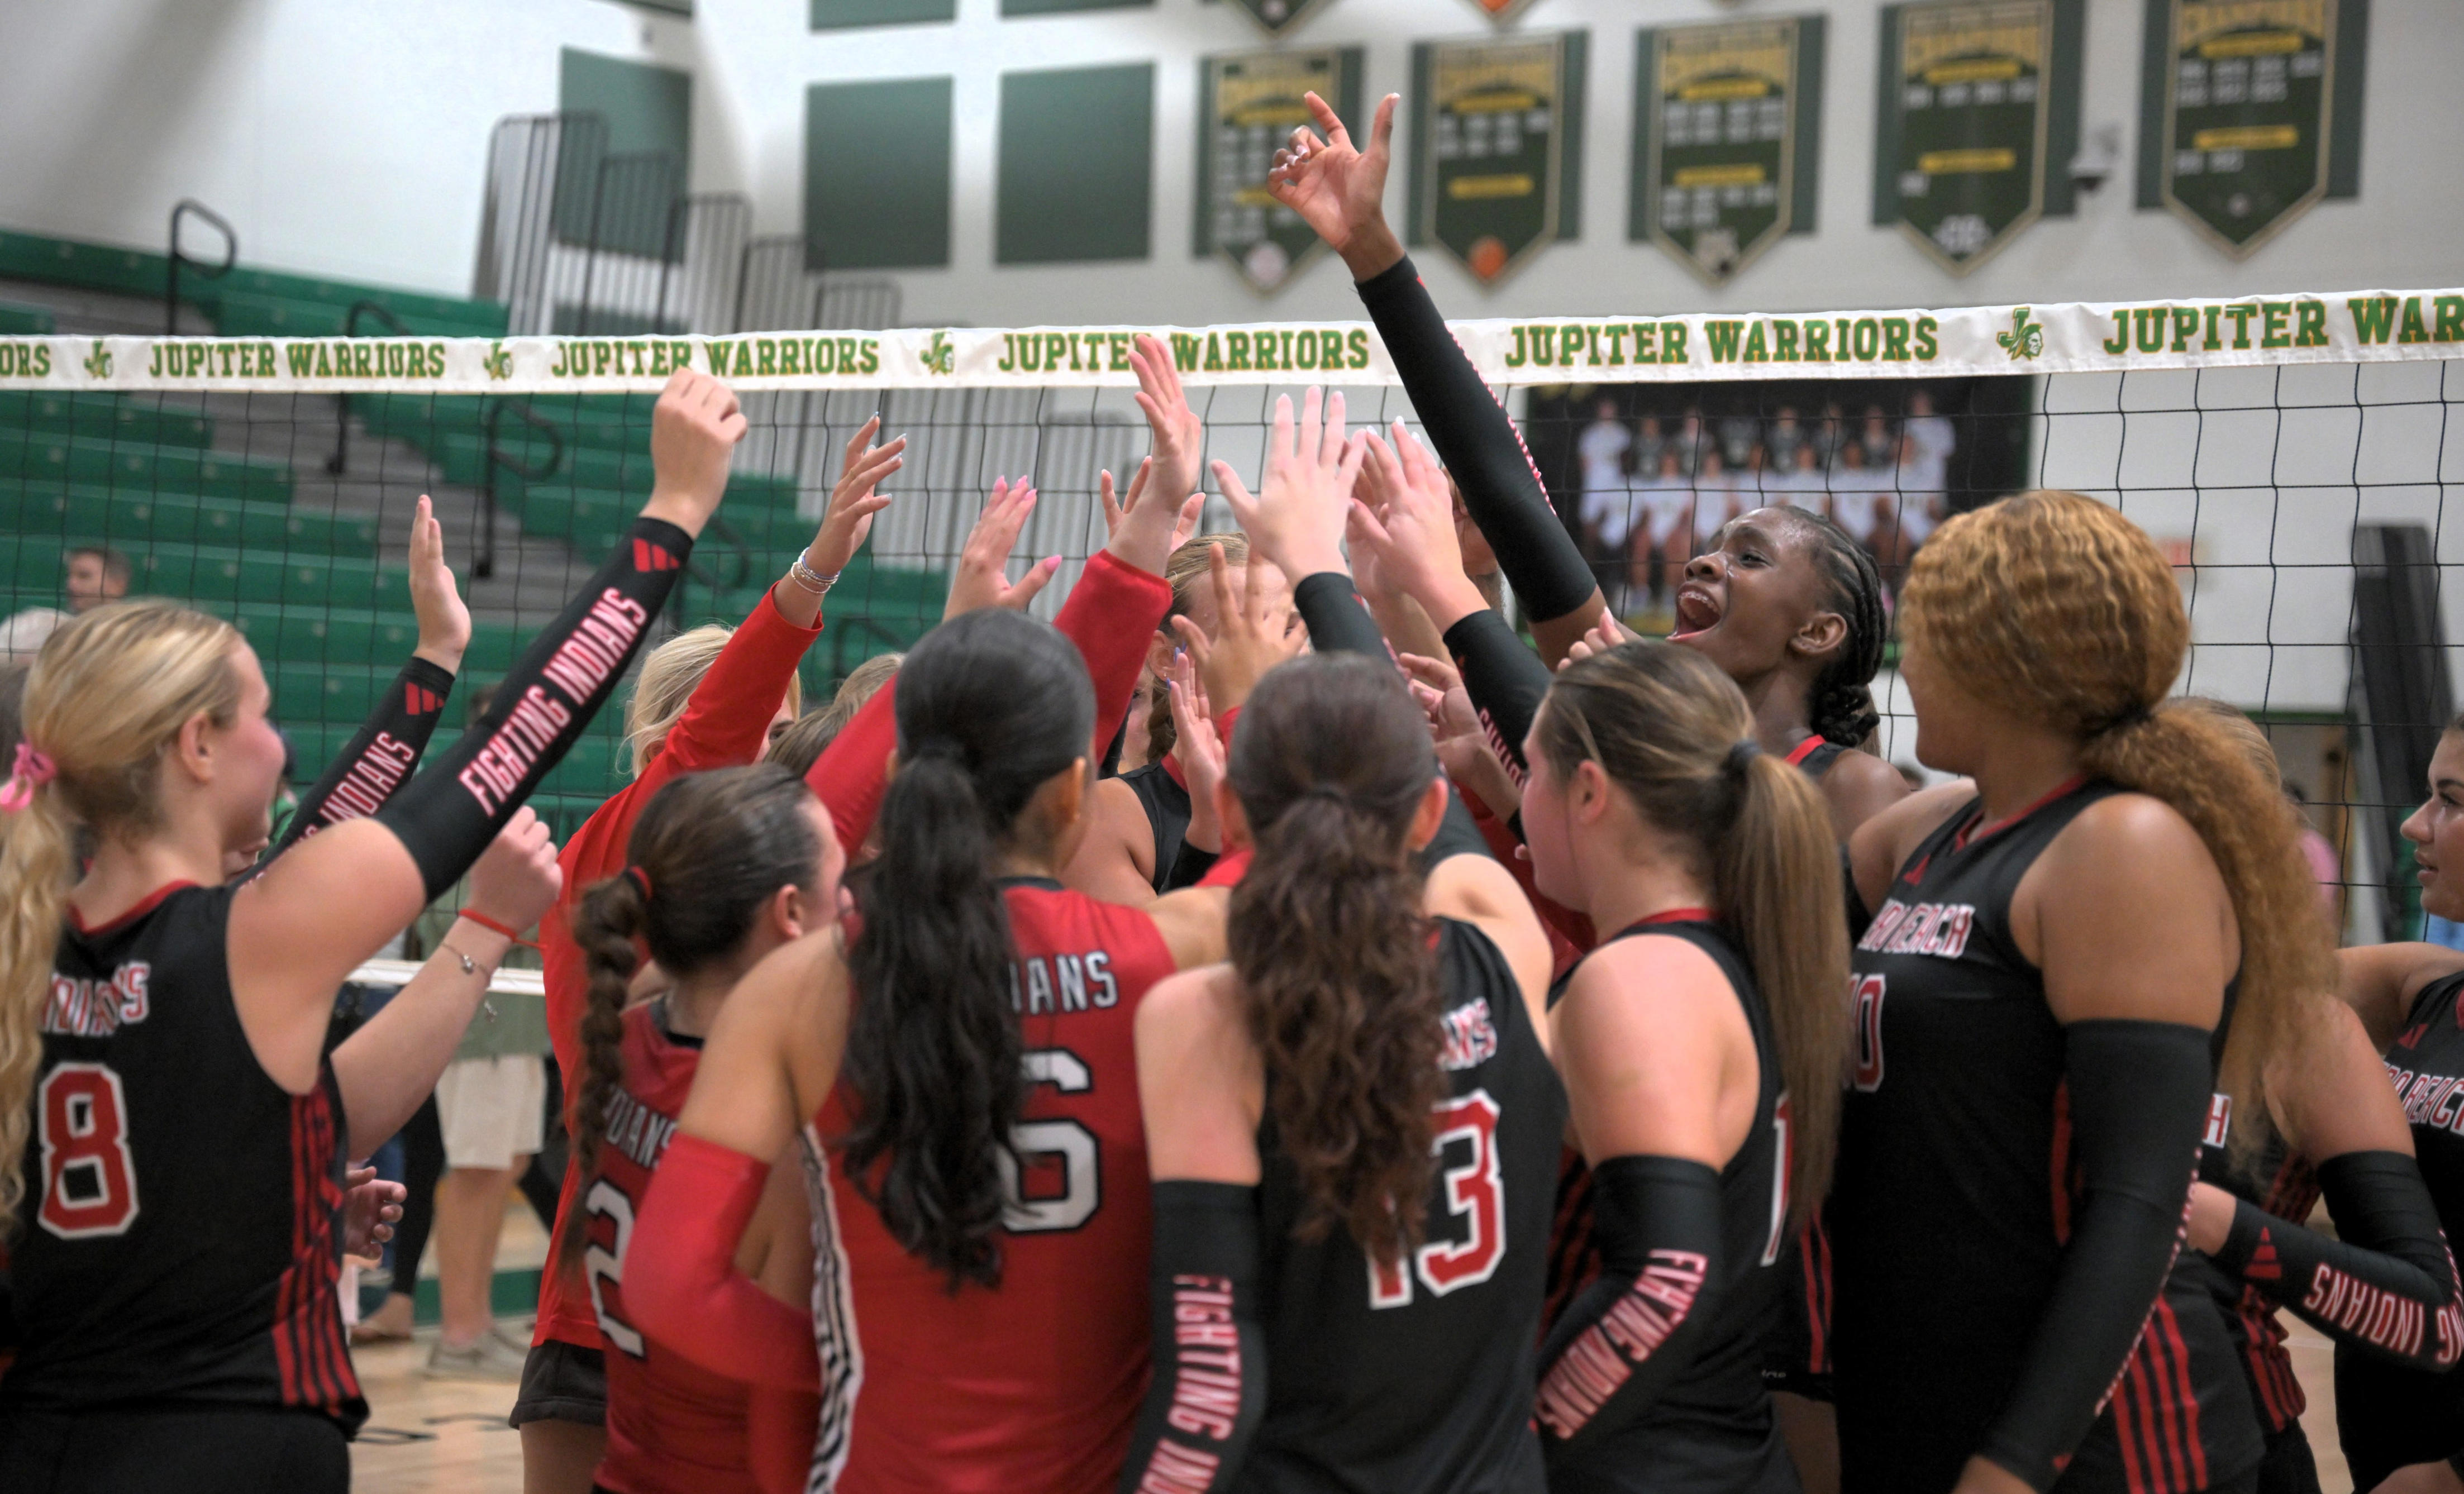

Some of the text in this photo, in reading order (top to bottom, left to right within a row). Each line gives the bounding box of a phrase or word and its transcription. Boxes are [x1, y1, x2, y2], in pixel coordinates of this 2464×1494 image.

[149, 342, 446, 379] JUPITER WARRIORS
[704, 337, 880, 378] WARRIORS
[1170, 330, 1369, 371] WARRIORS
[1505, 321, 1689, 367] JUPITER
[1703, 316, 1938, 364] WARRIORS
[2104, 295, 2464, 354] JUPITER WAR
[457, 586, 648, 819] FIGHTING INDIANS
[37, 1062, 140, 1239] 8
[585, 1179, 648, 1363] 2
[2303, 1261, 2426, 1358] INDIANS
[1167, 1273, 1242, 1442] FIGHTING
